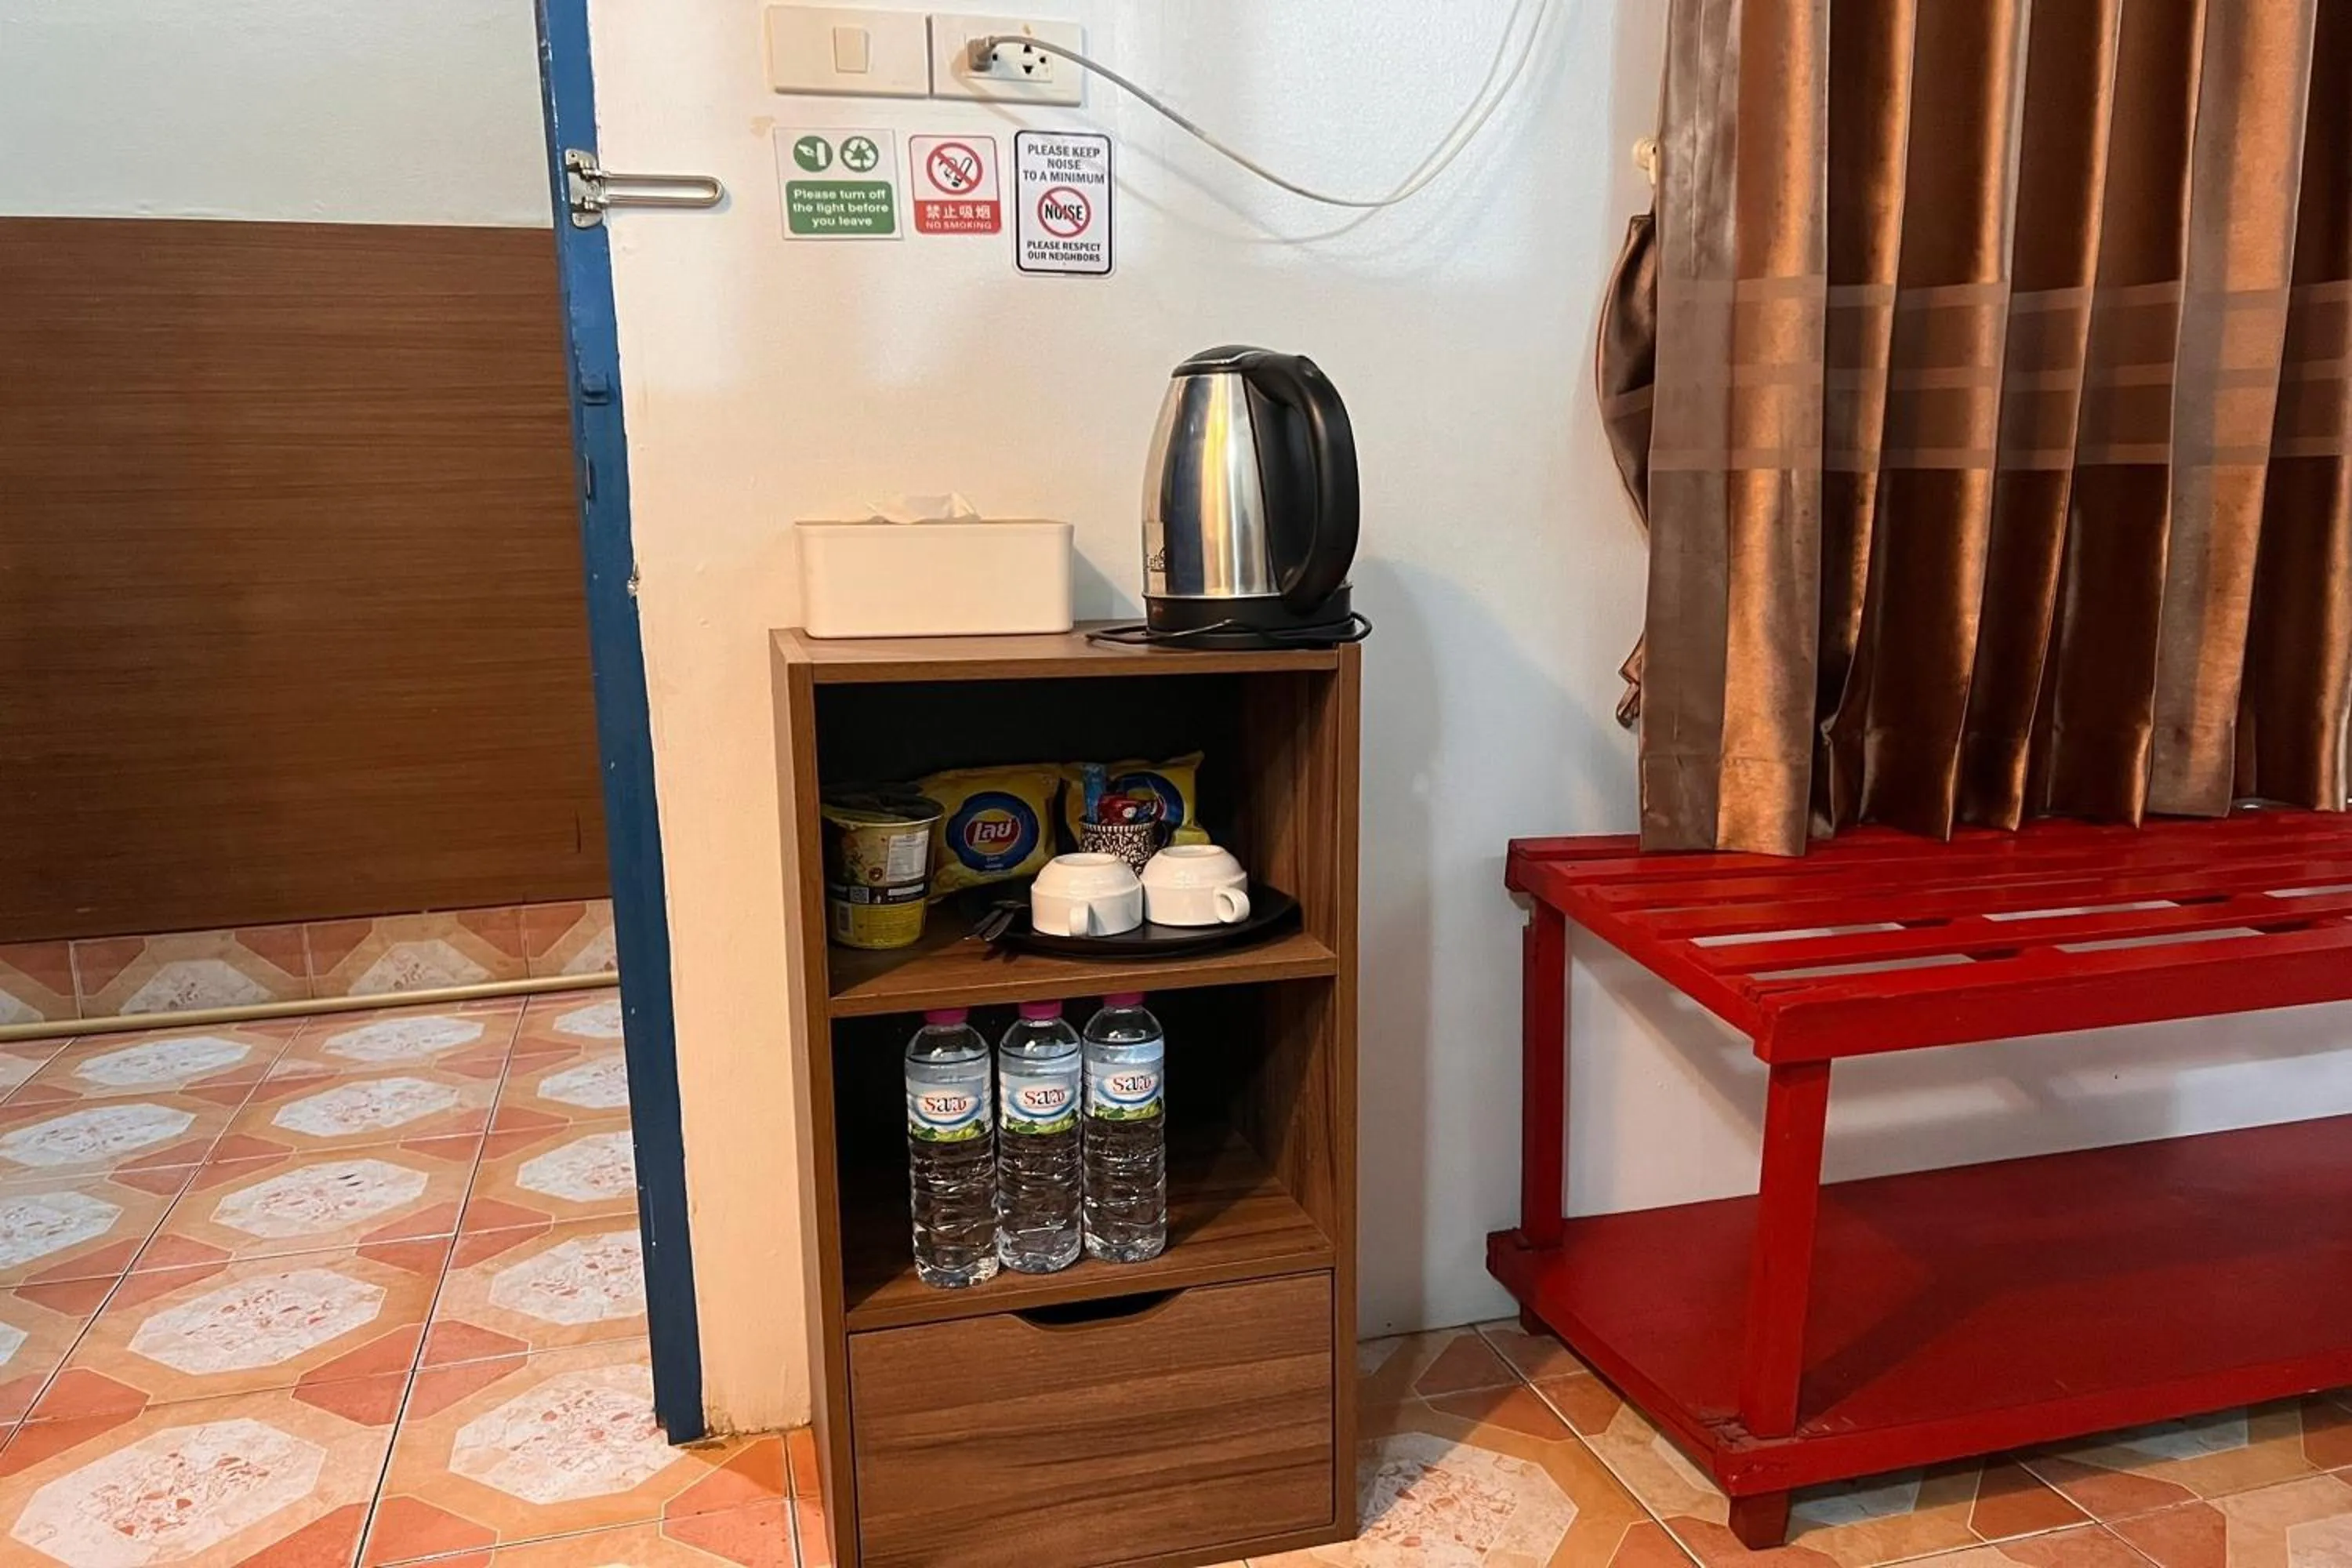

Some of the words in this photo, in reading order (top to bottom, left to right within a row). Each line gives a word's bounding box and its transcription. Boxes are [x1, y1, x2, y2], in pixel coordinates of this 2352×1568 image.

[1028, 144, 1069, 156] PLEASE
[1072, 147, 1100, 158] KEEP
[1047, 158, 1081, 169] NOISE
[1023, 170, 1037, 181] TO
[1040, 171, 1047, 182] A
[1050, 172, 1105, 184] MINIMUM
[793, 189, 837, 199] Please
[840, 190, 866, 198] turn
[868, 189, 886, 199] off
[793, 202, 813, 212] the
[816, 202, 844, 214] light
[848, 202, 888, 212] before
[926, 205, 991, 219] 禁止吸烟
[1045, 204, 1083, 220] NOISE
[812, 217, 835, 228] you
[838, 216, 873, 227] leave
[1027, 241, 1060, 250] PLEASE
[1062, 242, 1101, 252] RESPECT
[1028, 251, 1046, 260] OUR
[1048, 252, 1101, 262] NEIGHBORS
